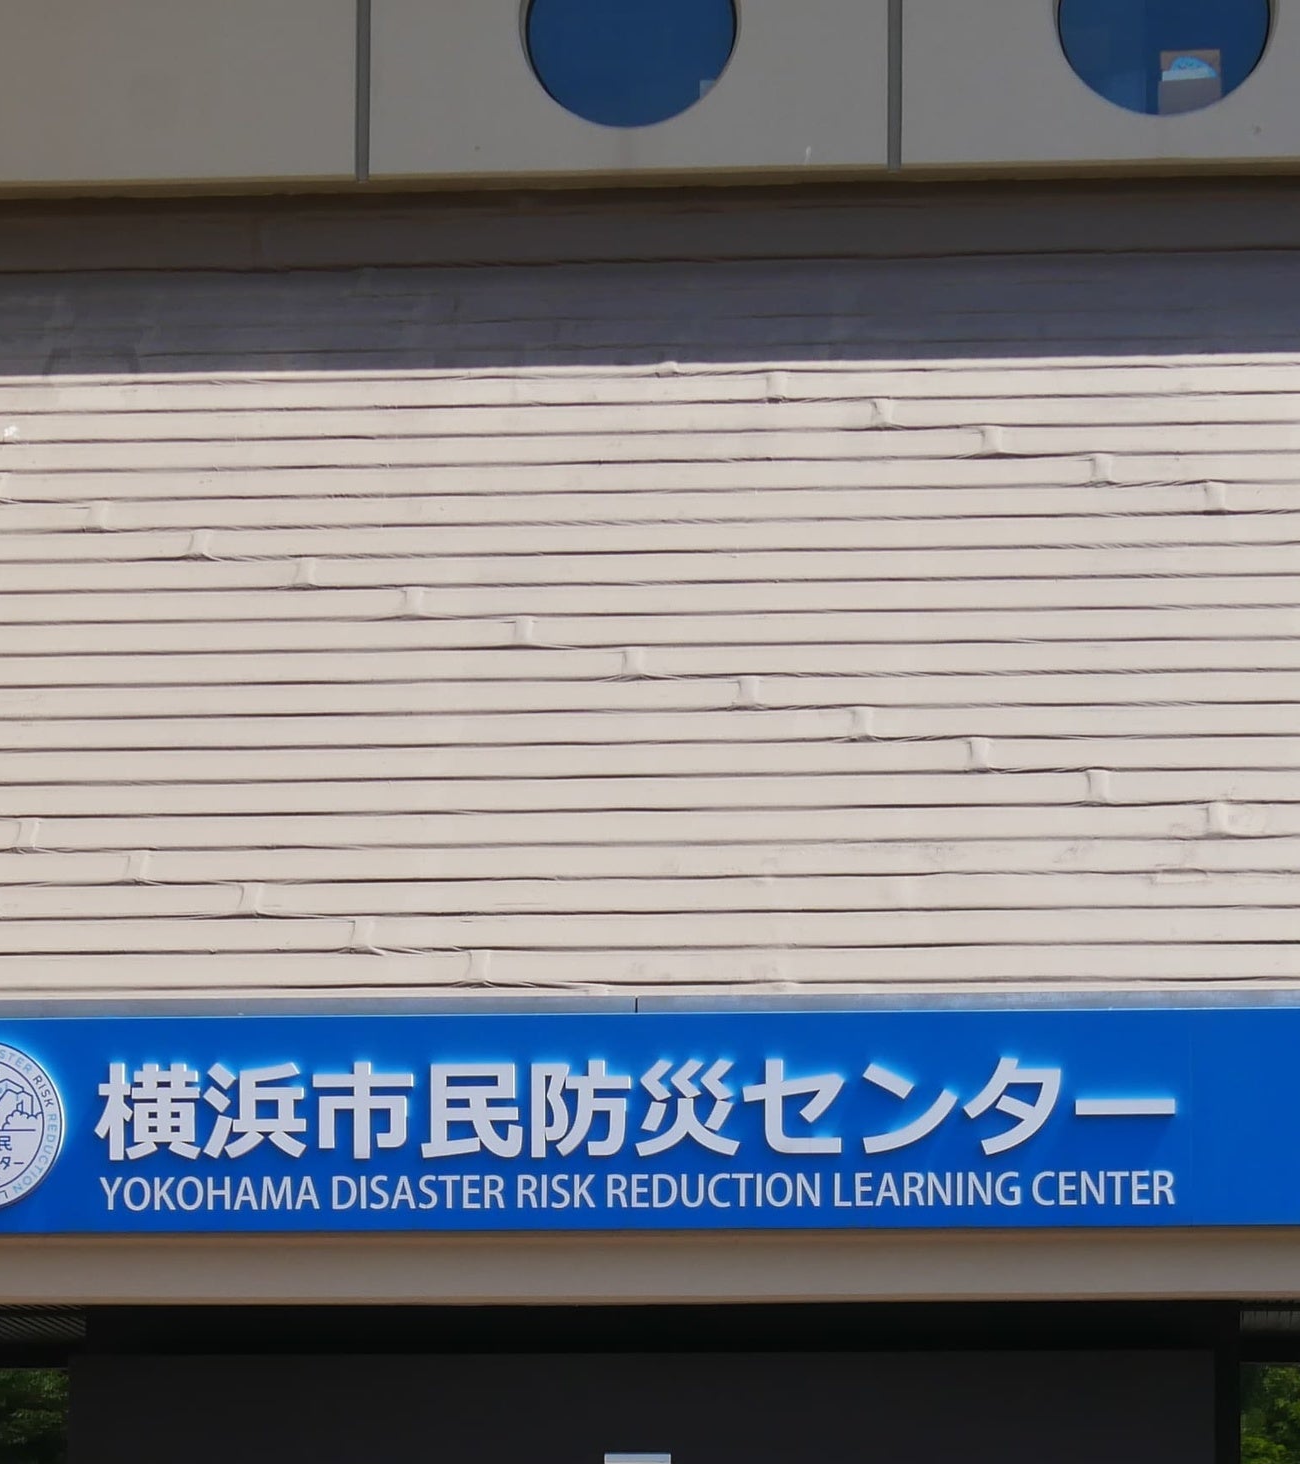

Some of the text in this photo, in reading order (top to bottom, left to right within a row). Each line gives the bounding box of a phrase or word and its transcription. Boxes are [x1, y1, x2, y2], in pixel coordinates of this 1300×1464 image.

[32, 1075, 55, 1108] RISK
[93, 1055, 1176, 1160] 横浜市民防災センター
[12, 1112, 58, 1194] REDUCTION
[99, 1170, 1176, 1211] YOKOHAMA DISASTER RISK REDUCTION LEARNING CENTER
